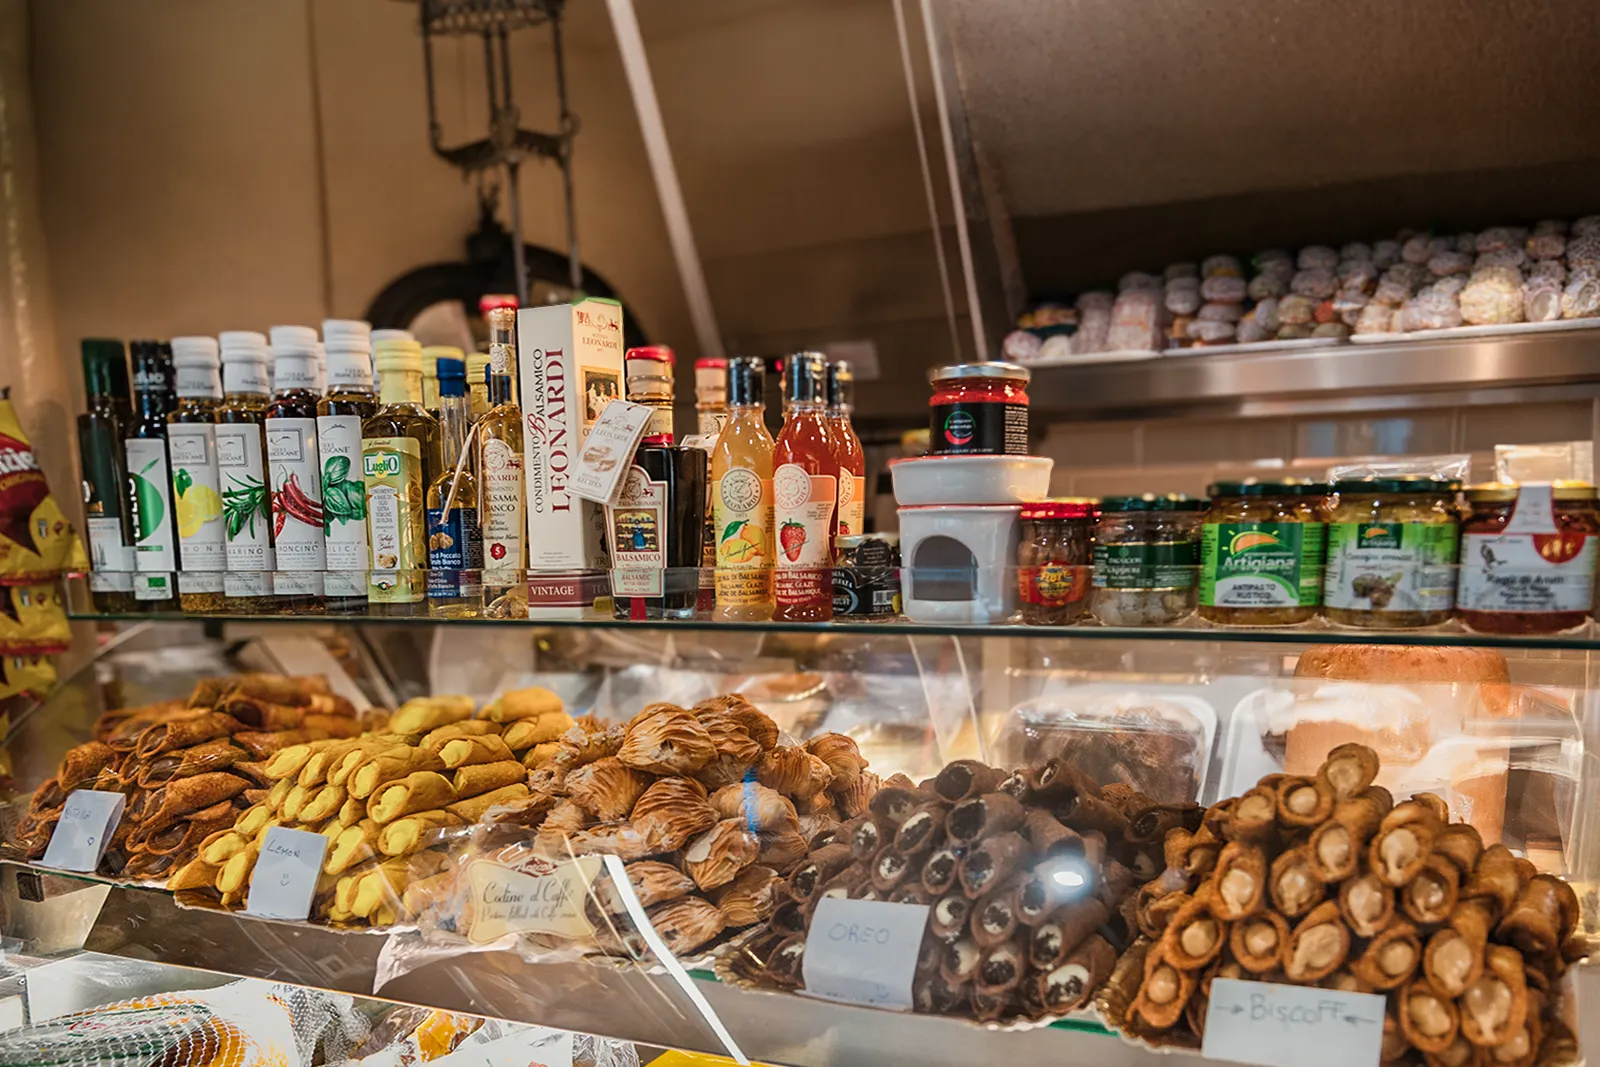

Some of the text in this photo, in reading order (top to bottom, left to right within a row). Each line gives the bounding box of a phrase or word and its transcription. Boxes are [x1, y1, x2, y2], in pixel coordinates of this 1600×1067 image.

[527, 348, 547, 513] CONDIMENTO BALSAMICO
[545, 347, 571, 513] LEONARDI
[494, 546, 501, 556] 5
[616, 553, 661, 562] BALSAMICO
[531, 585, 575, 596] VINTAGE
[828, 922, 891, 945] OREO
